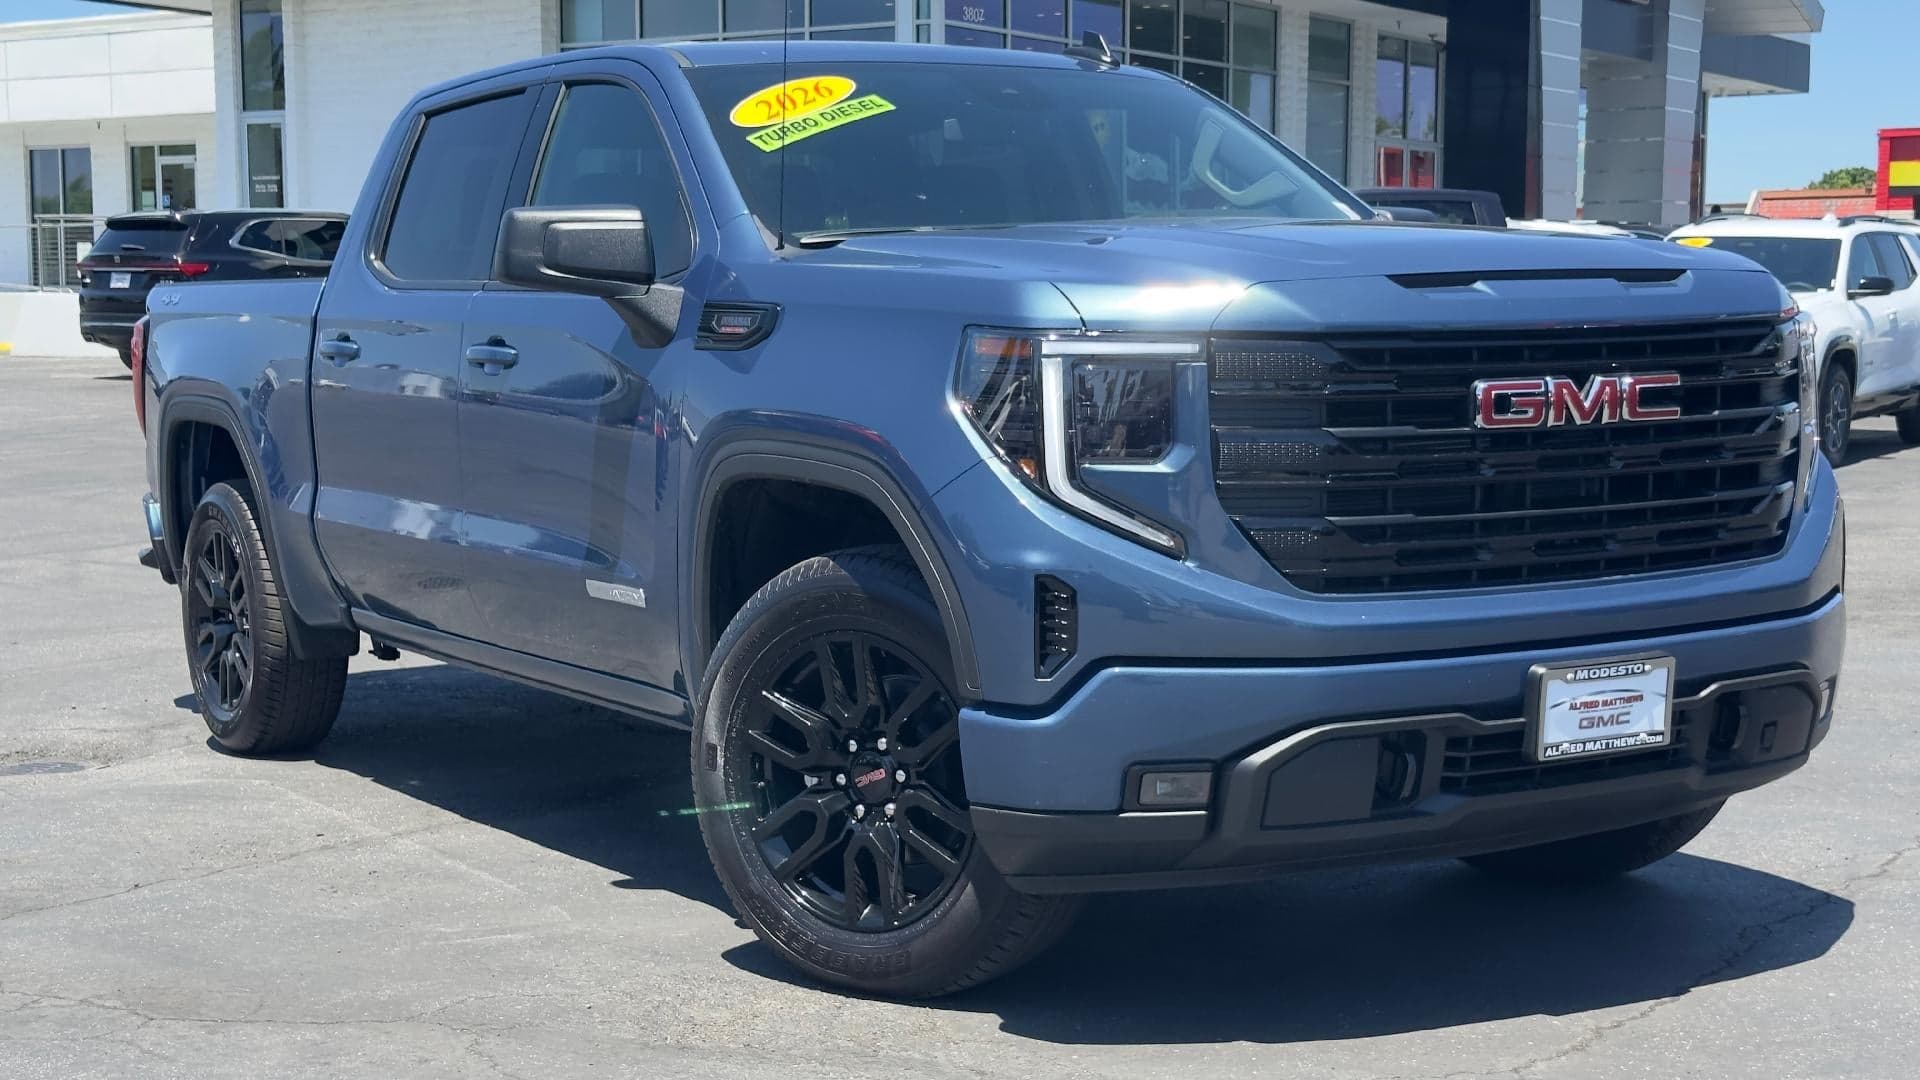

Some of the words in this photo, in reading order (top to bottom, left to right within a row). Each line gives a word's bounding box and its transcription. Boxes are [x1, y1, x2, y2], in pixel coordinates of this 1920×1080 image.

[756, 79, 833, 121] 2026
[754, 117, 819, 146] TURBO
[820, 98, 884, 122] DIESEL
[1473, 373, 1681, 430] GMC
[1575, 663, 1644, 681] MODESTO
[1569, 699, 1600, 711] ALFRED
[1601, 694, 1644, 708] MATTHEWS
[1578, 711, 1631, 730] GMC
